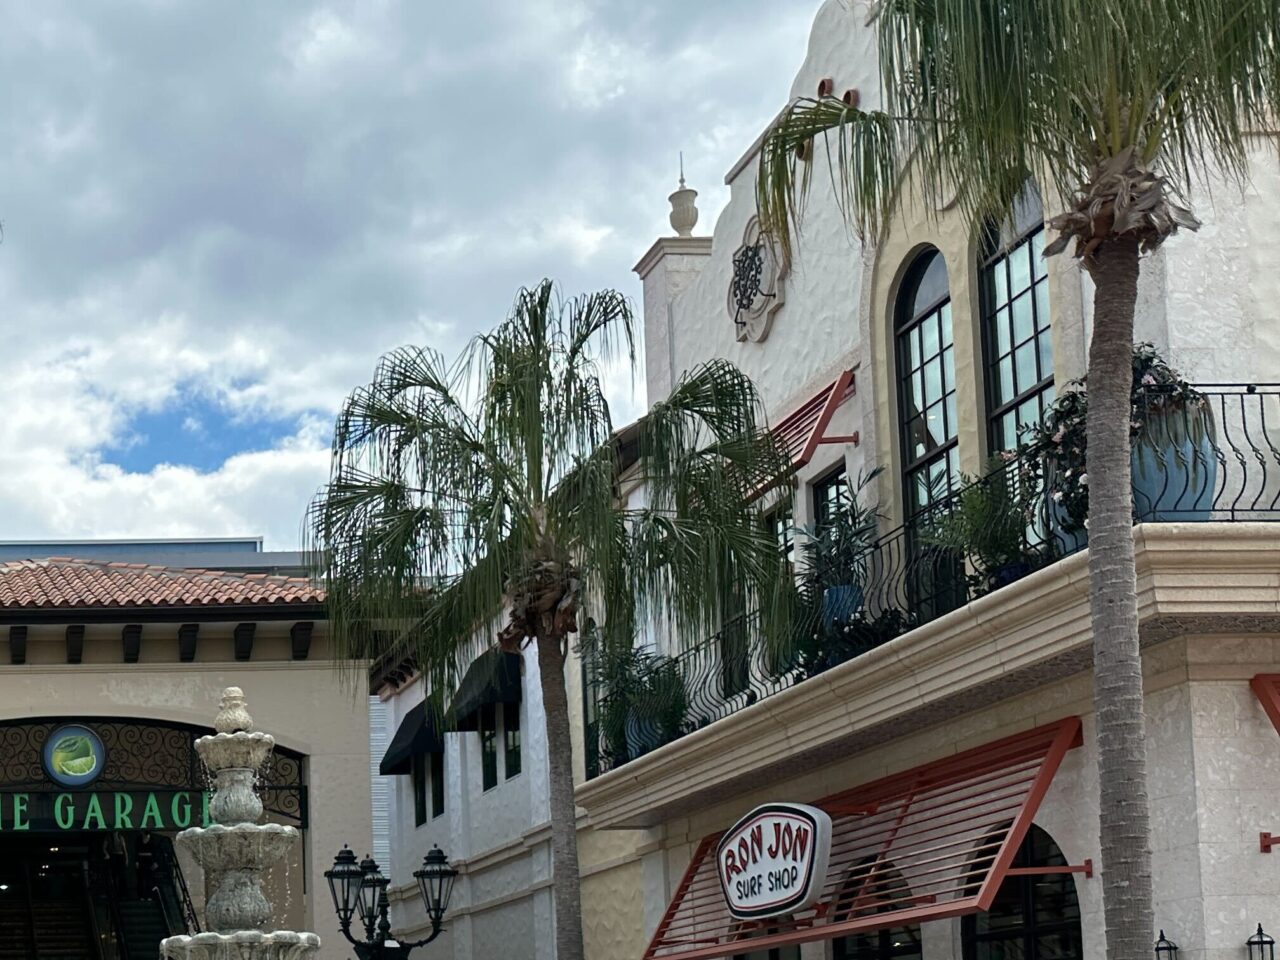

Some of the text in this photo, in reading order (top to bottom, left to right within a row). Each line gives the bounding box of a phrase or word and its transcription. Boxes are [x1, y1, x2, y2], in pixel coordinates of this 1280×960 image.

[724, 820, 809, 886] RON JON
[736, 865, 798, 900] SURF SHOP
